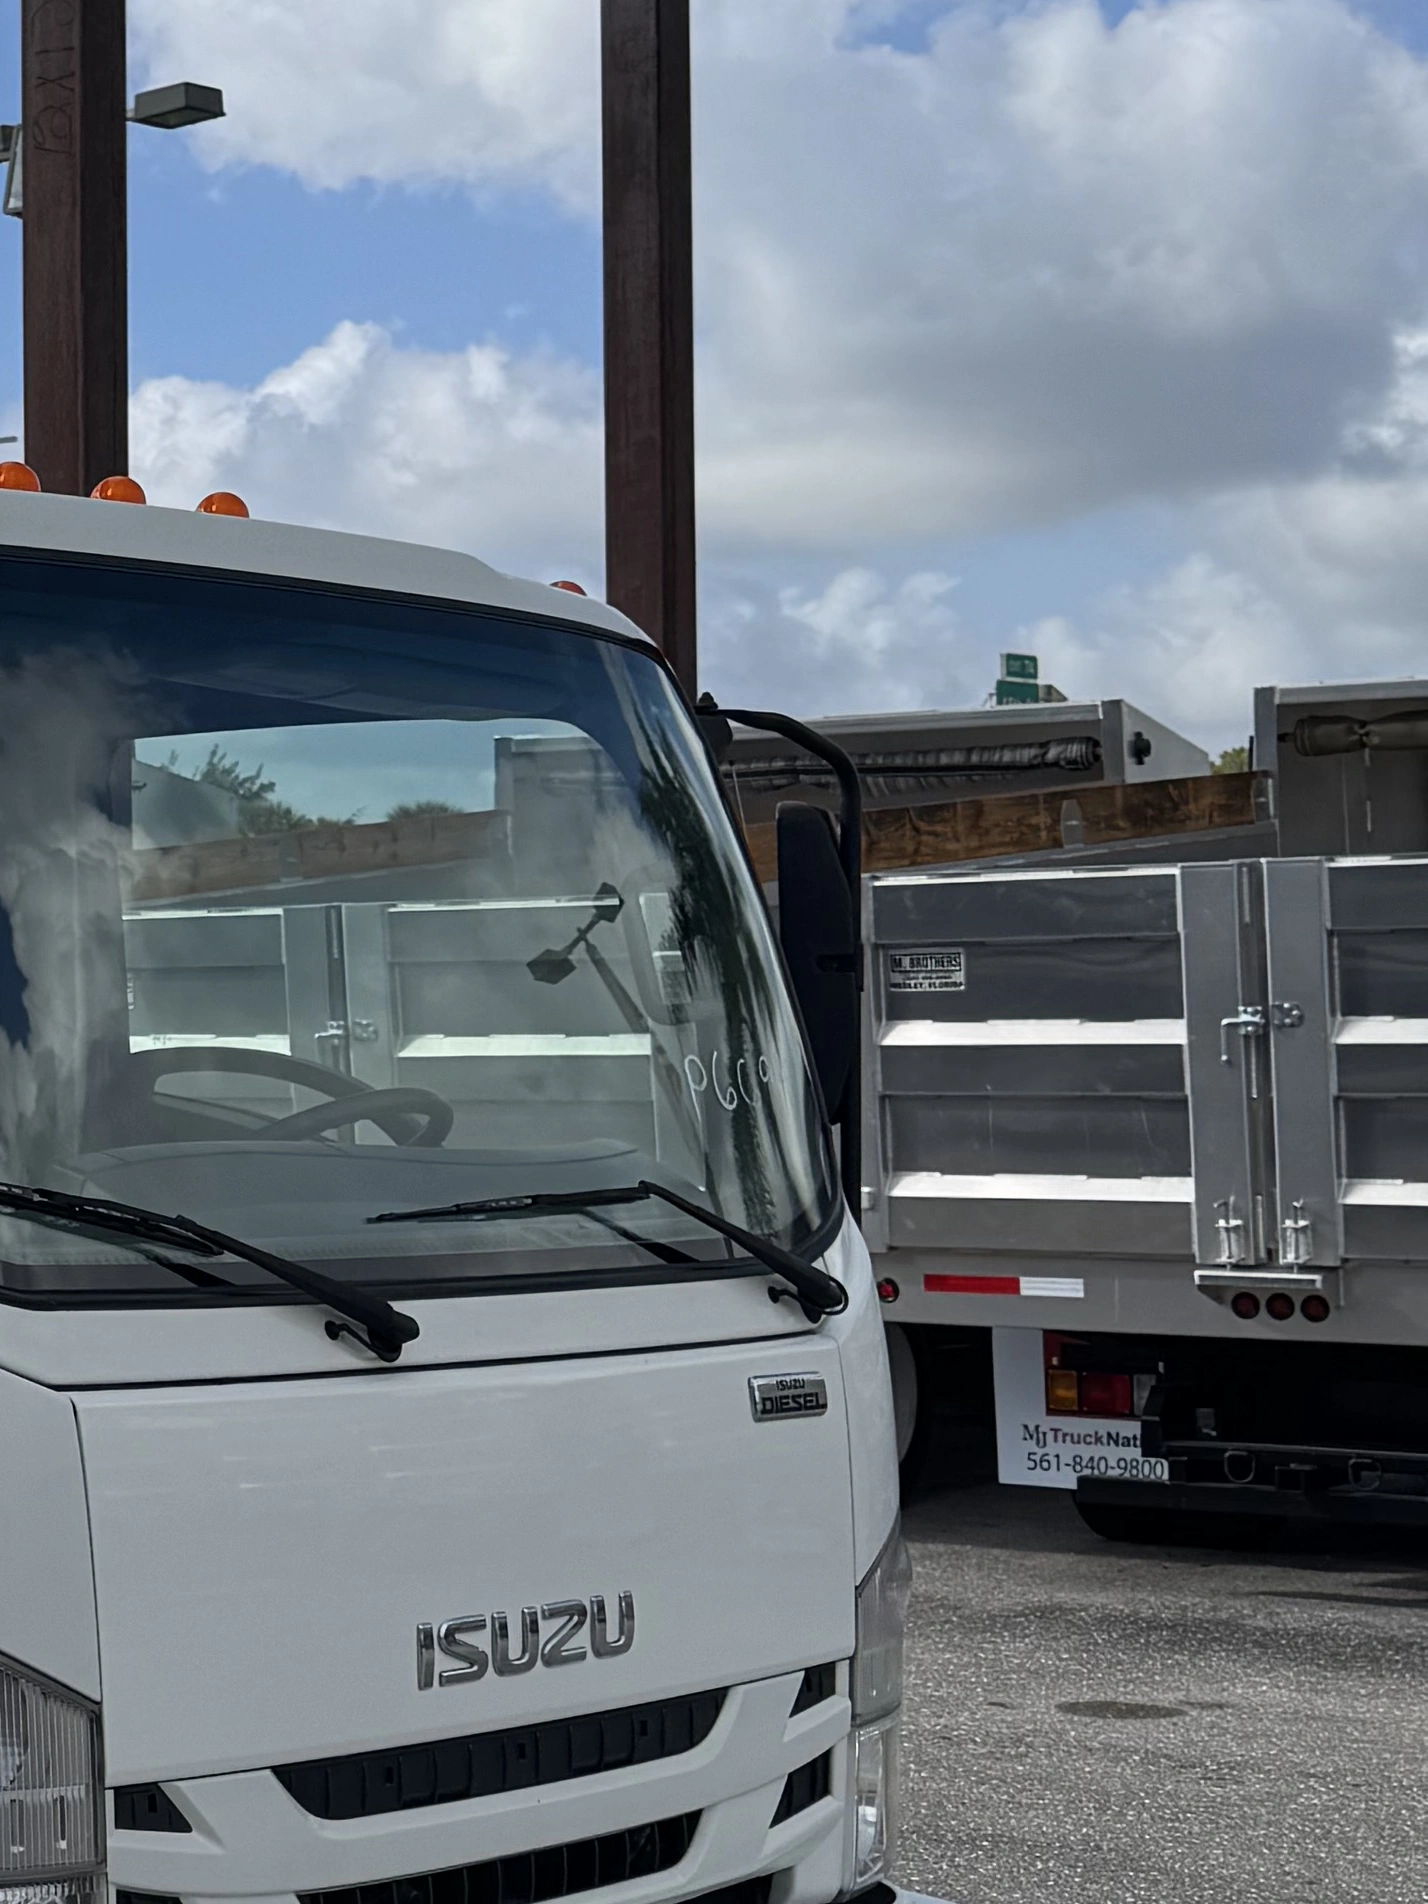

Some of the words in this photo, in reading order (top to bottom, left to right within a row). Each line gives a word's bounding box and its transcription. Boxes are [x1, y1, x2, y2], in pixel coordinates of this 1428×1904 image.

[775, 1377, 805, 1391] ISUZU
[760, 1392, 828, 1415] DIESEL
[1049, 1428, 1141, 1448] TruckNat
[1026, 1452, 1164, 1479] 561-840-9800
[416, 1590, 635, 1691] ISUZU
